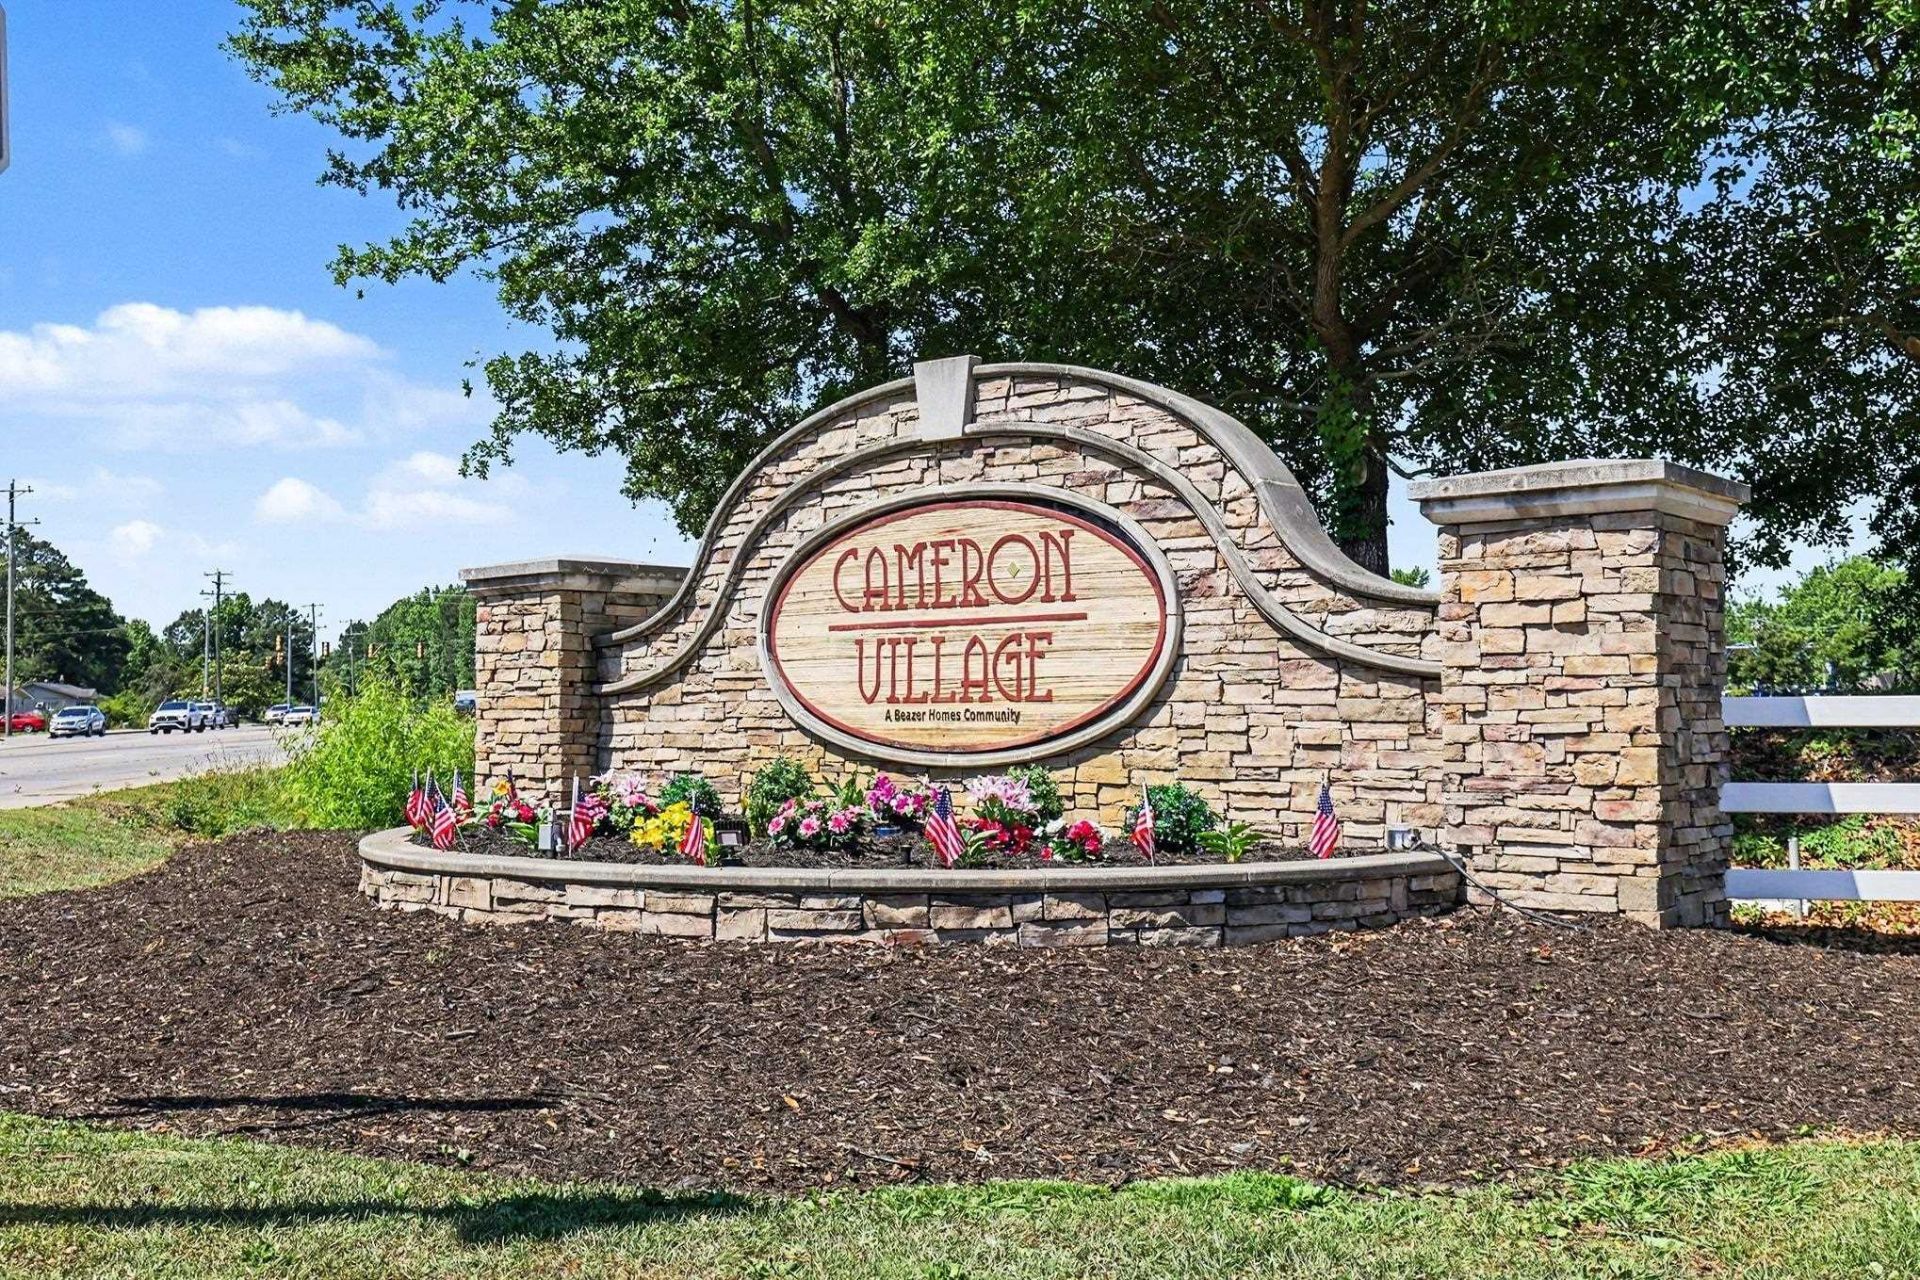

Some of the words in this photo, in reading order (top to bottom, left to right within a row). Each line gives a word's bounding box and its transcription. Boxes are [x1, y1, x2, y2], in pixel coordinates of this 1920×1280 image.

[833, 529, 1077, 613] CAMERON
[854, 631, 1053, 705] VILLAGE
[885, 709, 893, 722] A
[894, 709, 926, 722] Beazer
[928, 708, 961, 722] Homes
[964, 707, 1021, 725] Community
